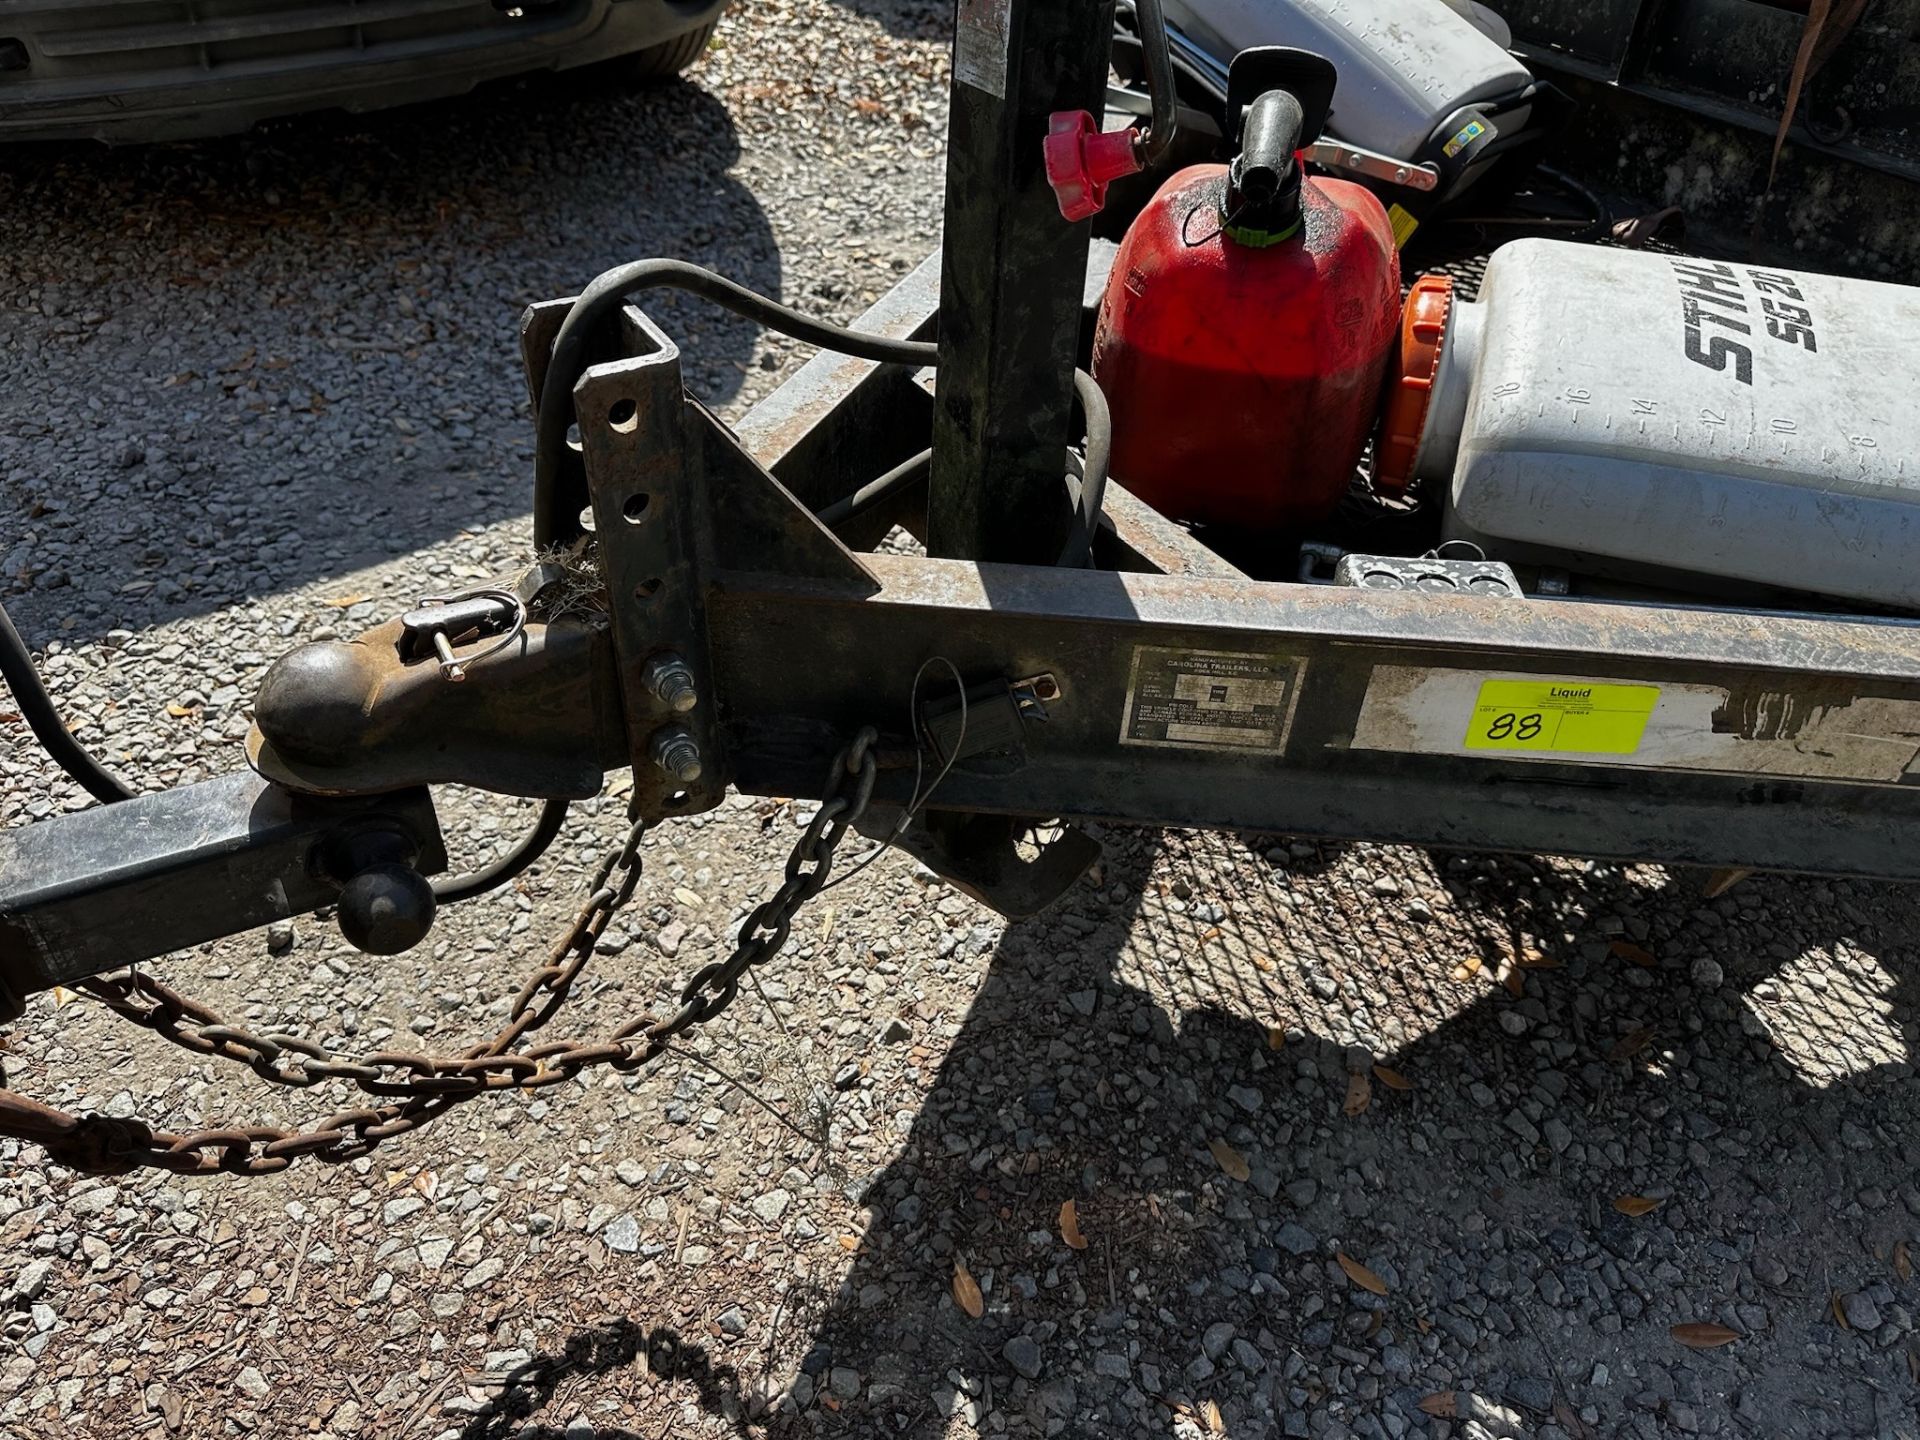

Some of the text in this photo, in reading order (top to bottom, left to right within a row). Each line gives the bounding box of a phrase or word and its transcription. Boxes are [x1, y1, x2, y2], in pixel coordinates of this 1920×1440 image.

[1746, 269, 1817, 353] SG 20
[1670, 261, 1752, 386] STIHL
[1564, 387, 1592, 405] 16
[1630, 398, 1658, 416] 14
[1698, 407, 1727, 425] 12
[1769, 417, 1797, 436] 10
[1848, 434, 1877, 448] 8
[1550, 687, 1592, 699] Liquid
[1486, 712, 1542, 741] 88
